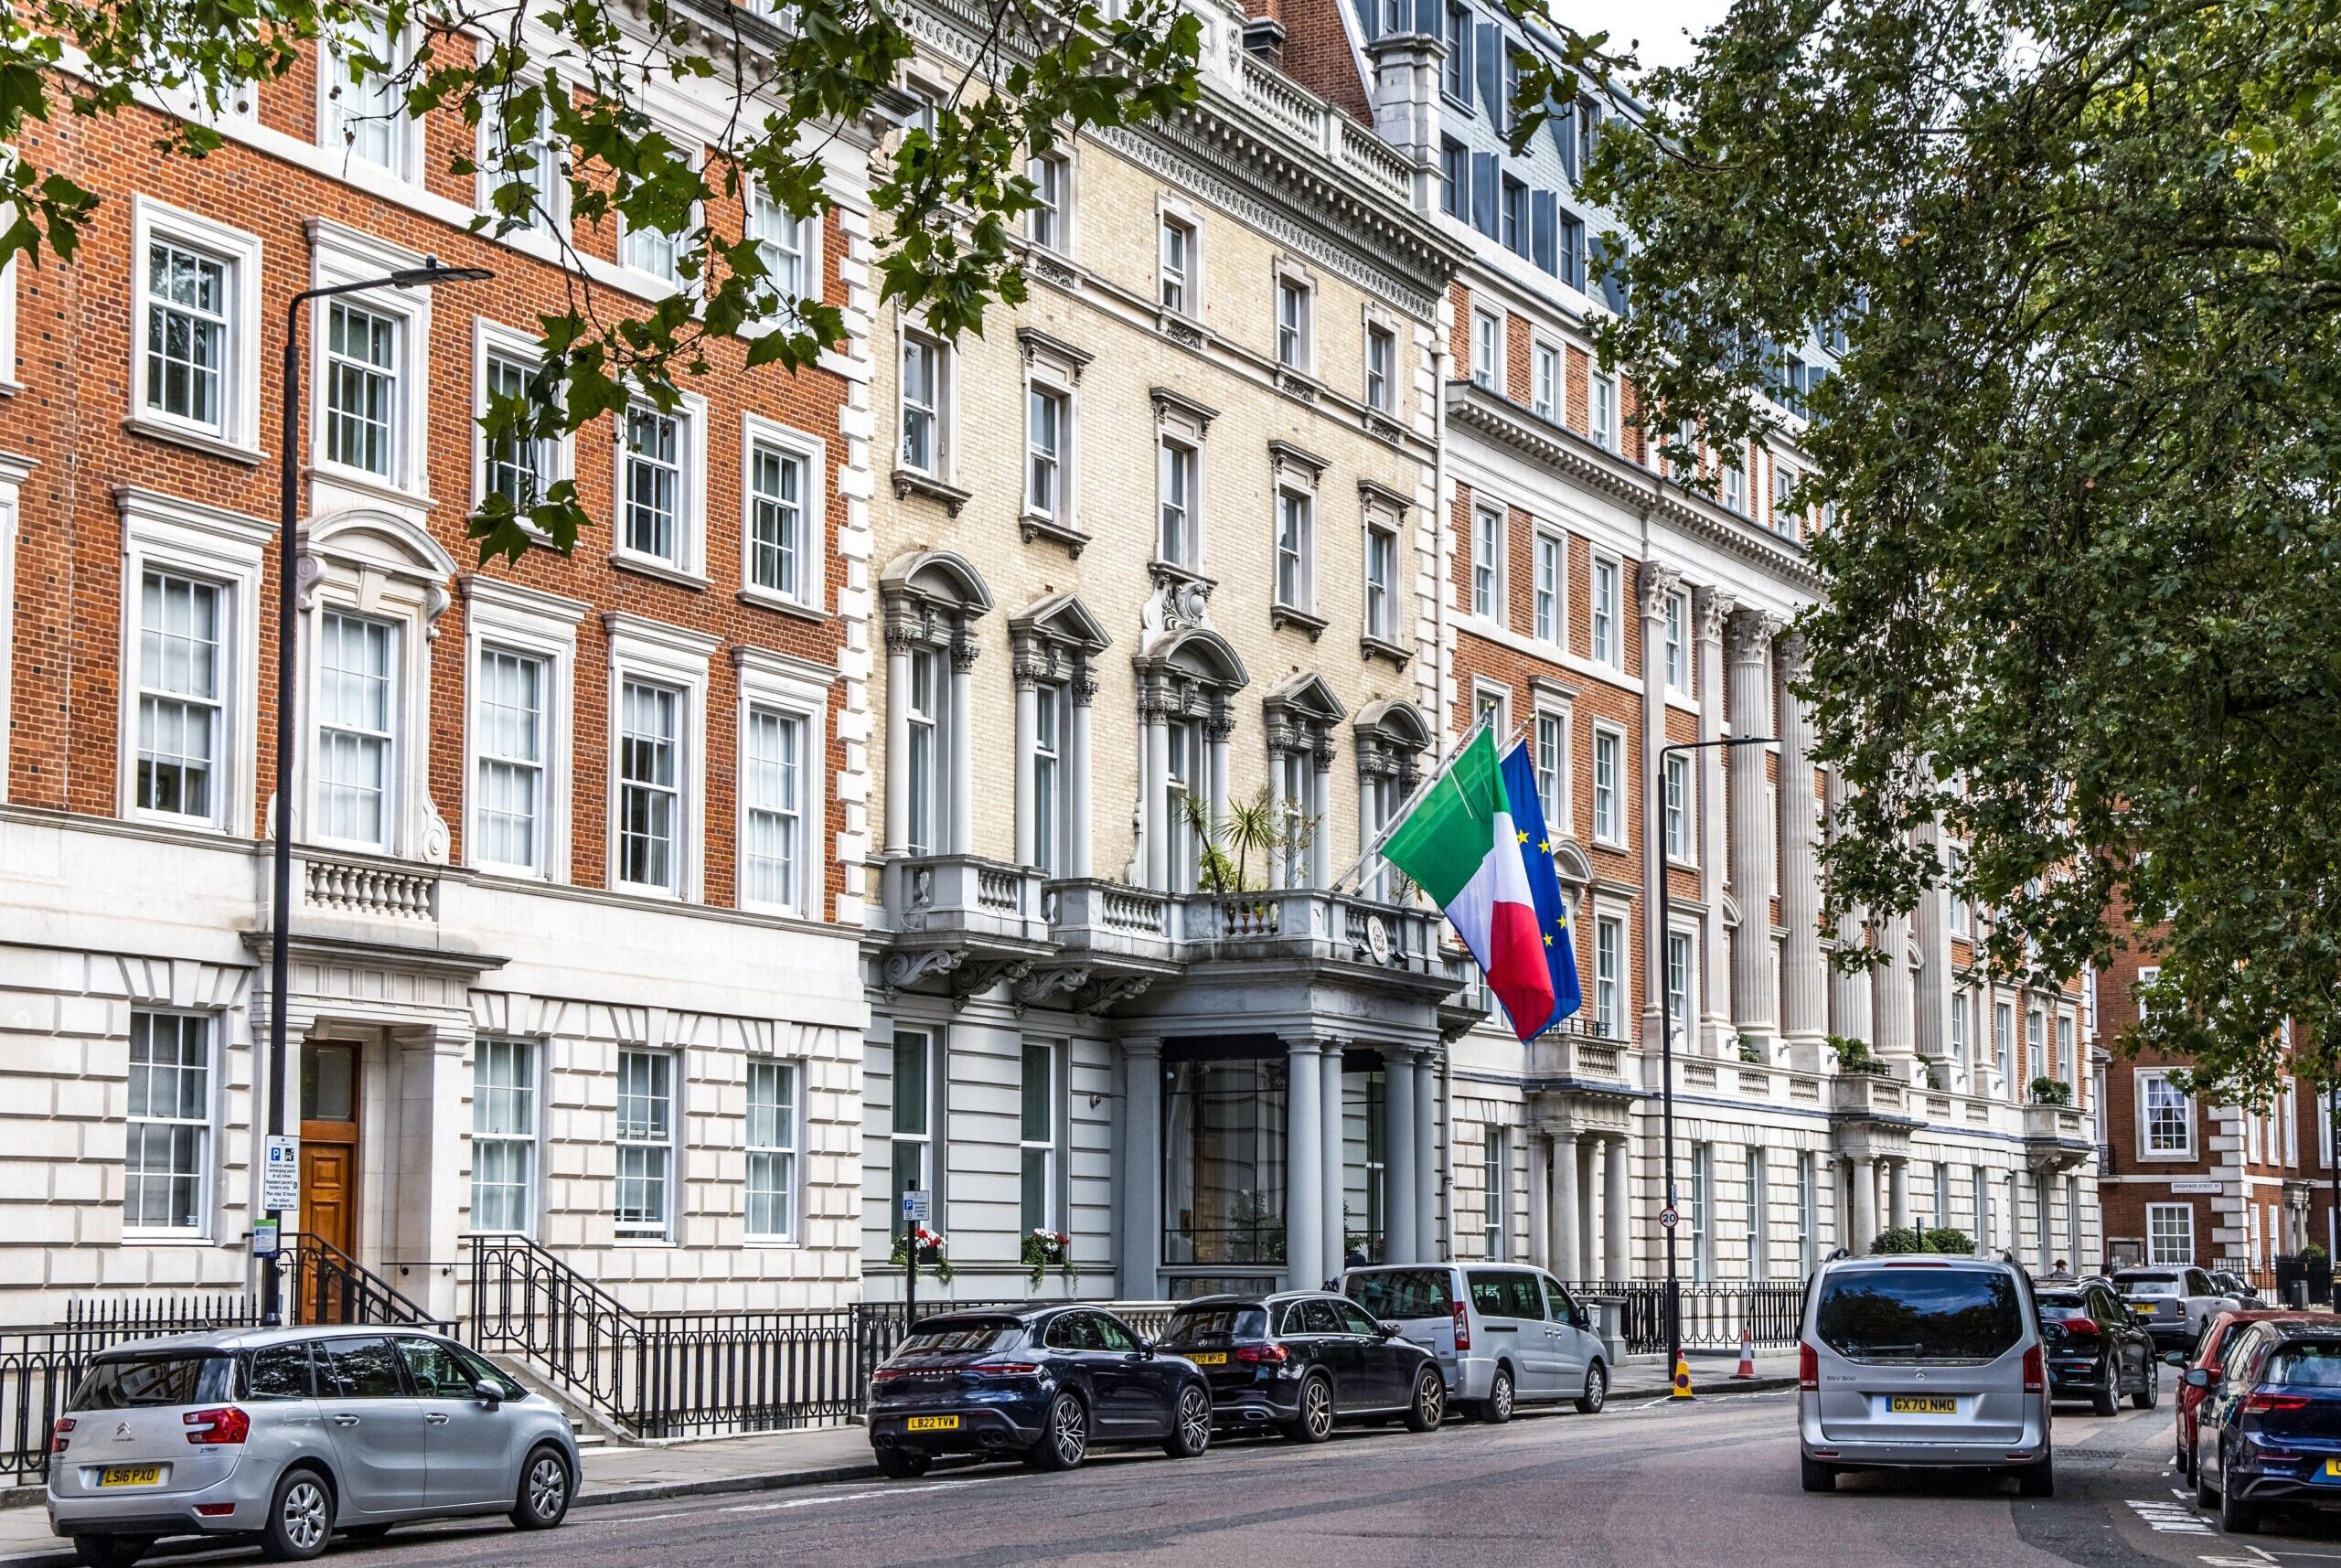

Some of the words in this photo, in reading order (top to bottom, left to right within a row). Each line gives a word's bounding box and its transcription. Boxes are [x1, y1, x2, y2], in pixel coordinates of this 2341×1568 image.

[1663, 1214, 1676, 1222] 20
[1894, 1399, 1927, 1410] GX70
[1930, 1400, 1955, 1411] NMO
[912, 1419, 935, 1428] LB22
[106, 1470, 130, 1483] LS16
